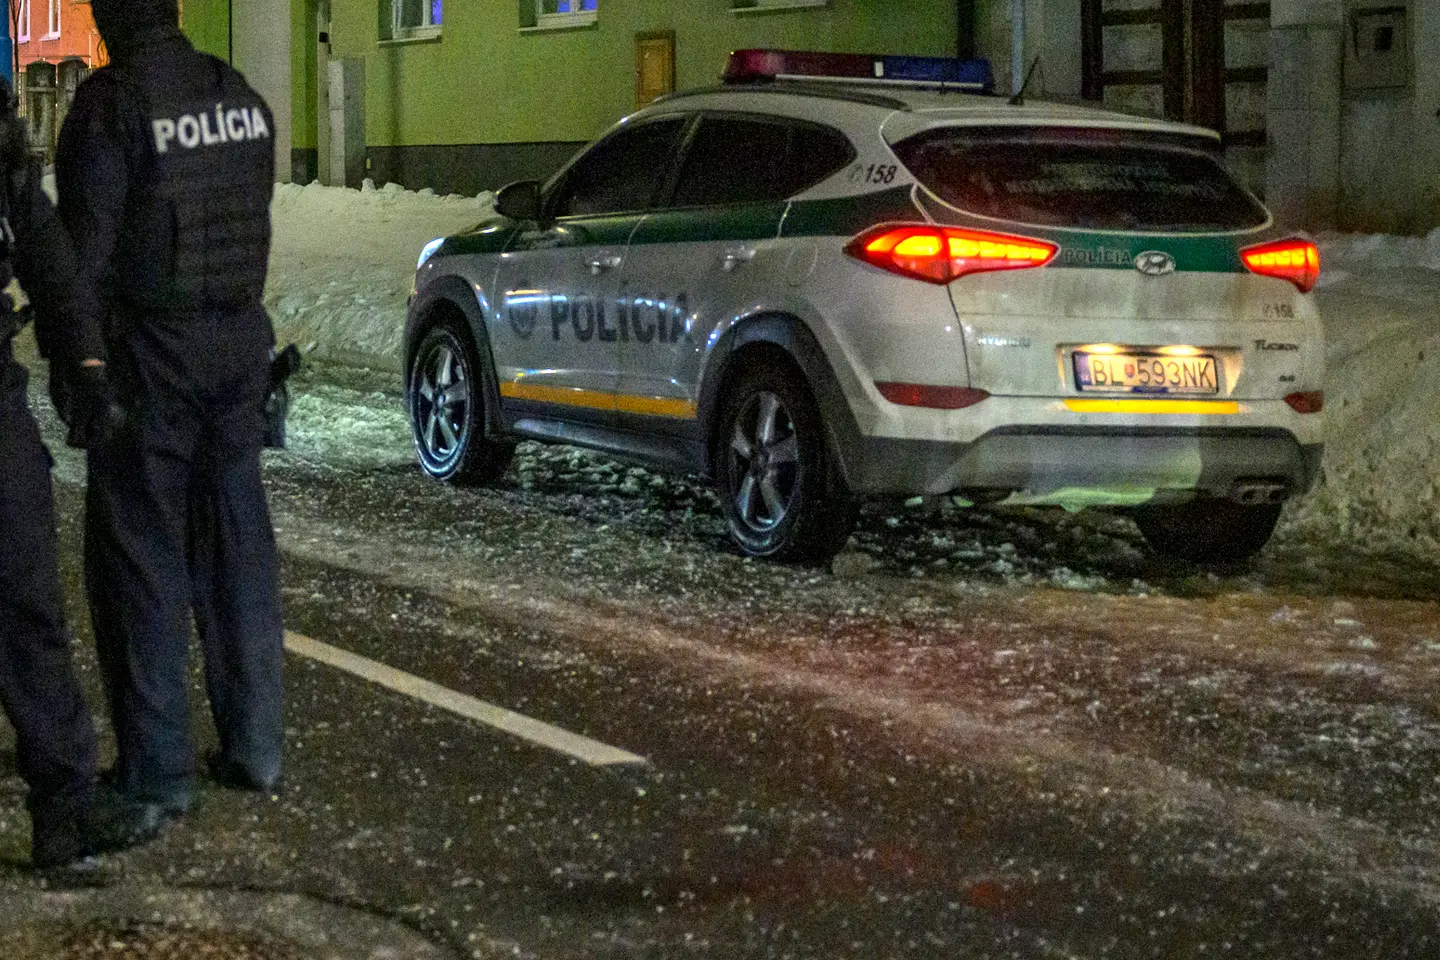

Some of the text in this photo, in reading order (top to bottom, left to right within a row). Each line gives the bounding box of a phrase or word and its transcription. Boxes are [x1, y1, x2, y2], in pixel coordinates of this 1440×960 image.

[152, 102, 269, 153] POLÍCIA
[865, 164, 897, 183] 158
[1092, 359, 1213, 387] BL 593NK
